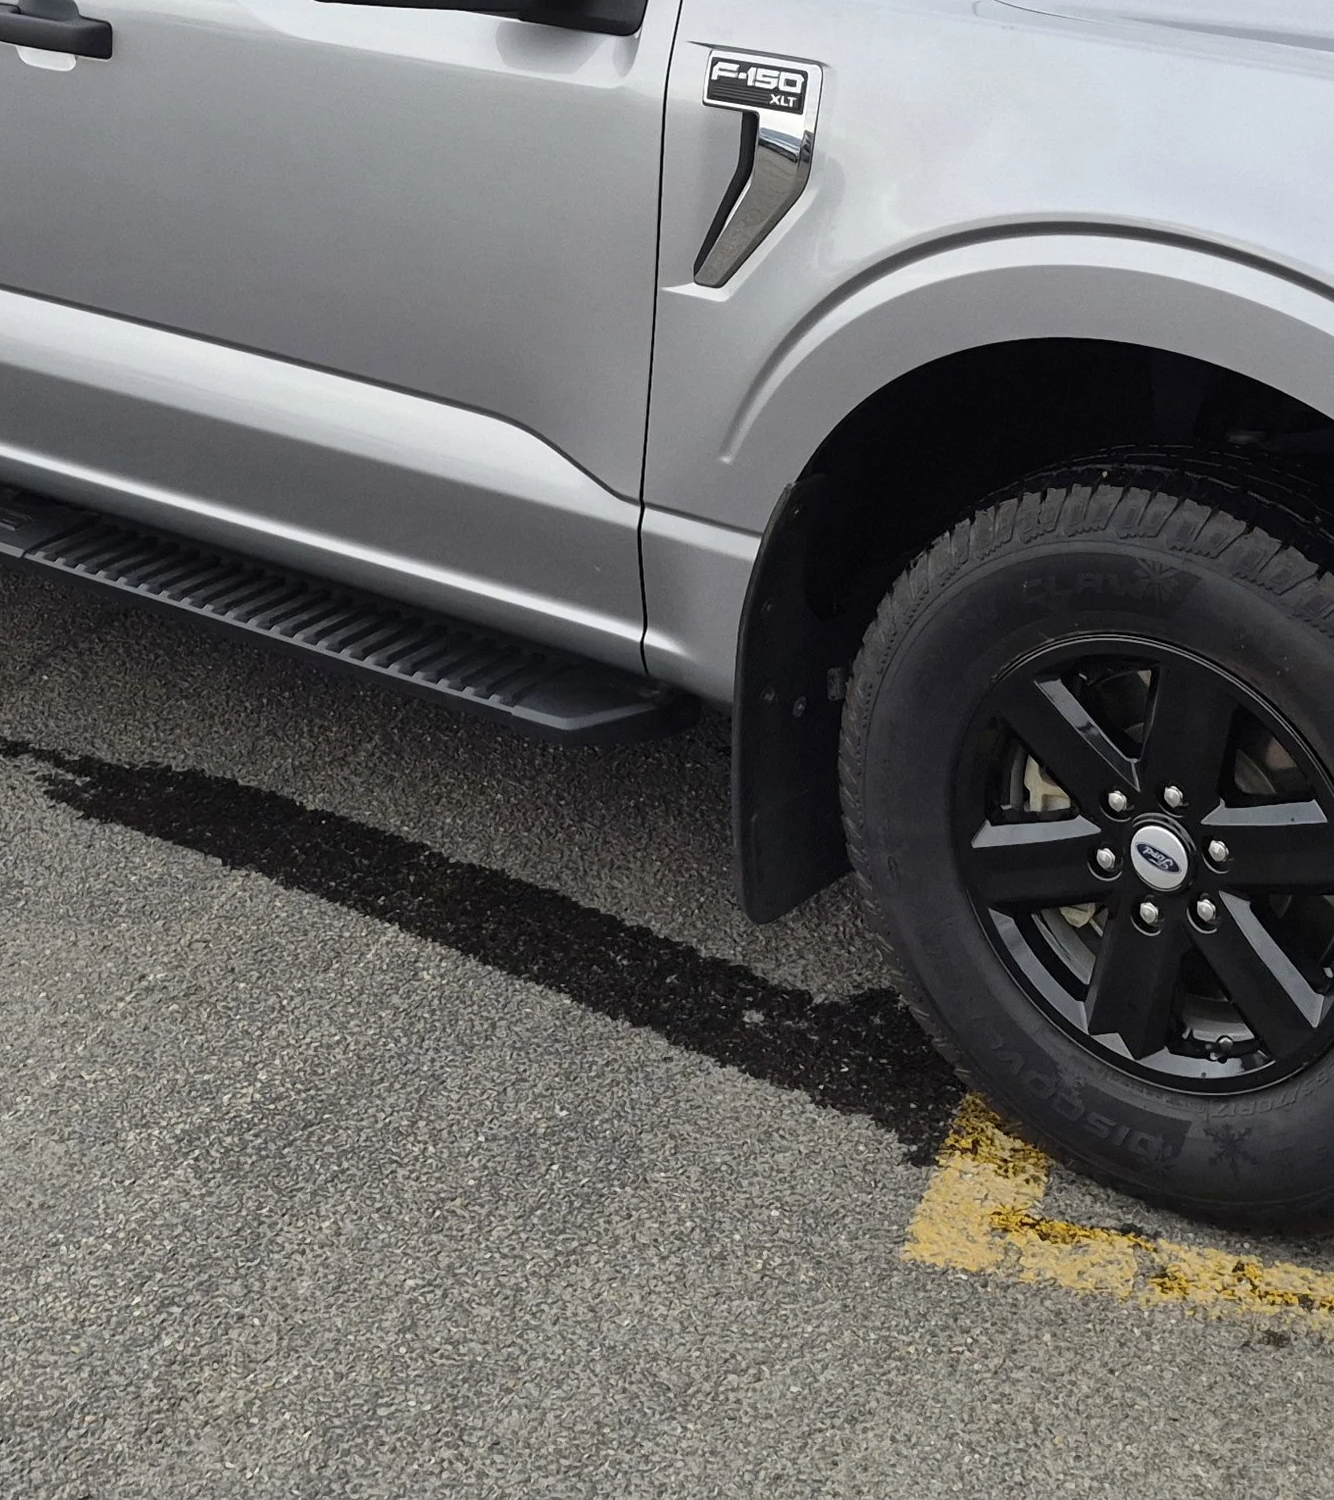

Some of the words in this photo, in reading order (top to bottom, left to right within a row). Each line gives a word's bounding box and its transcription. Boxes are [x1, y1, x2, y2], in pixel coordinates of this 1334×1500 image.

[710, 61, 805, 94] F-150
[769, 93, 797, 108] XLT
[1141, 845, 1174, 870] Ford
